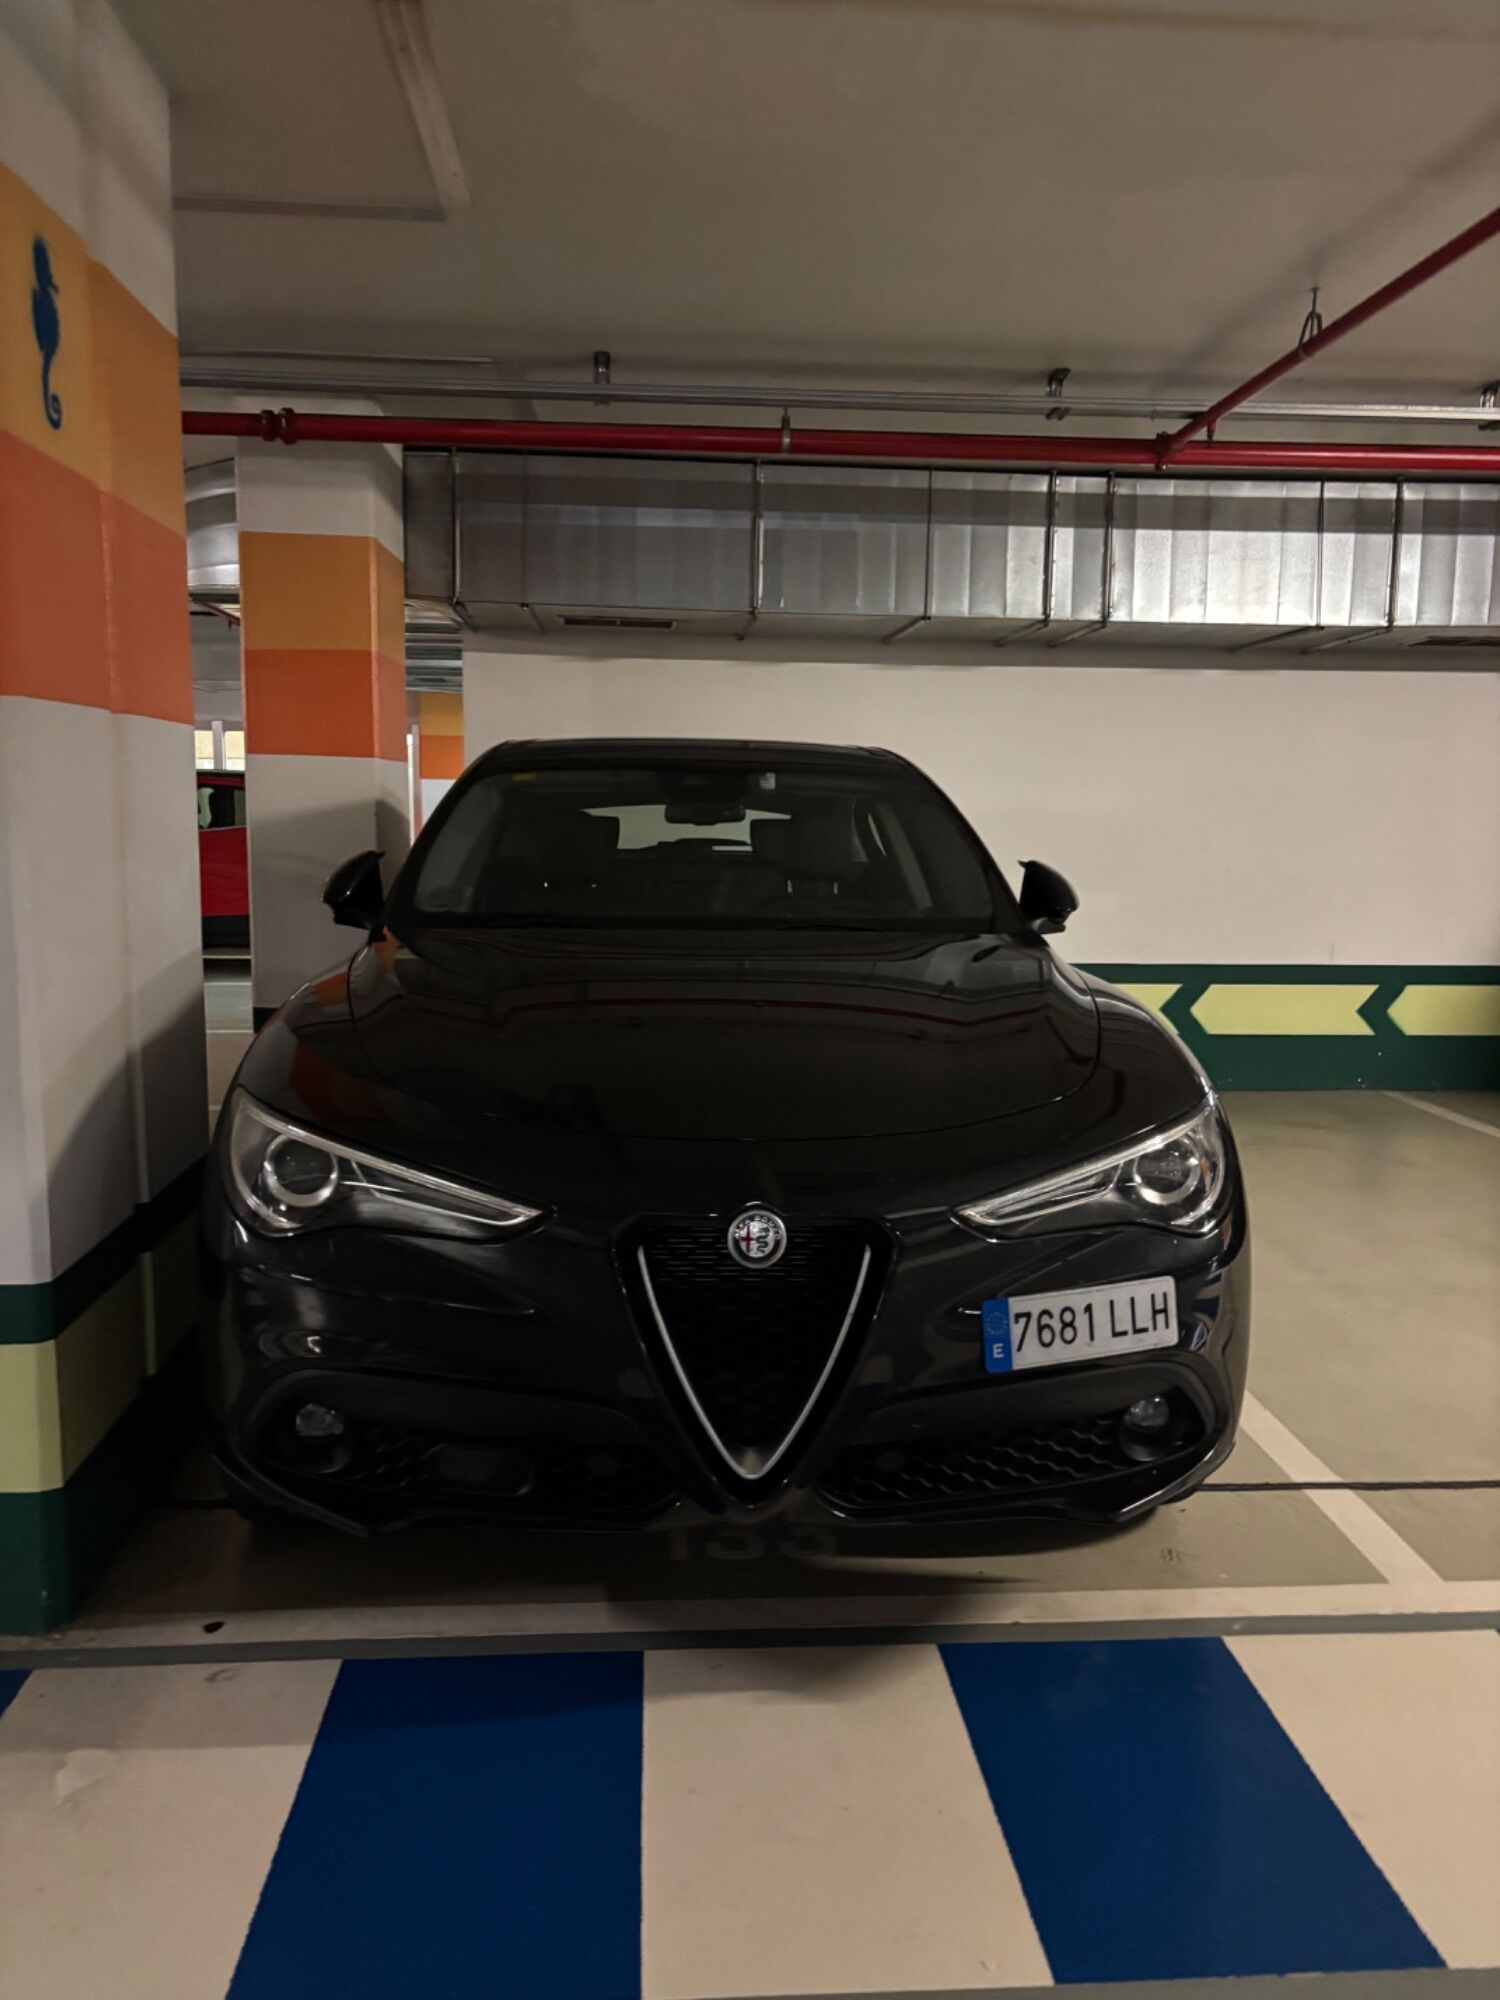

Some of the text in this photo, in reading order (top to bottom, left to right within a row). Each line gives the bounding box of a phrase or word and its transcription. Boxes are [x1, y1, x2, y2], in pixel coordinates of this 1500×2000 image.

[1013, 1291, 1170, 1353] 7681 LLH
[992, 1343, 1005, 1358] E
